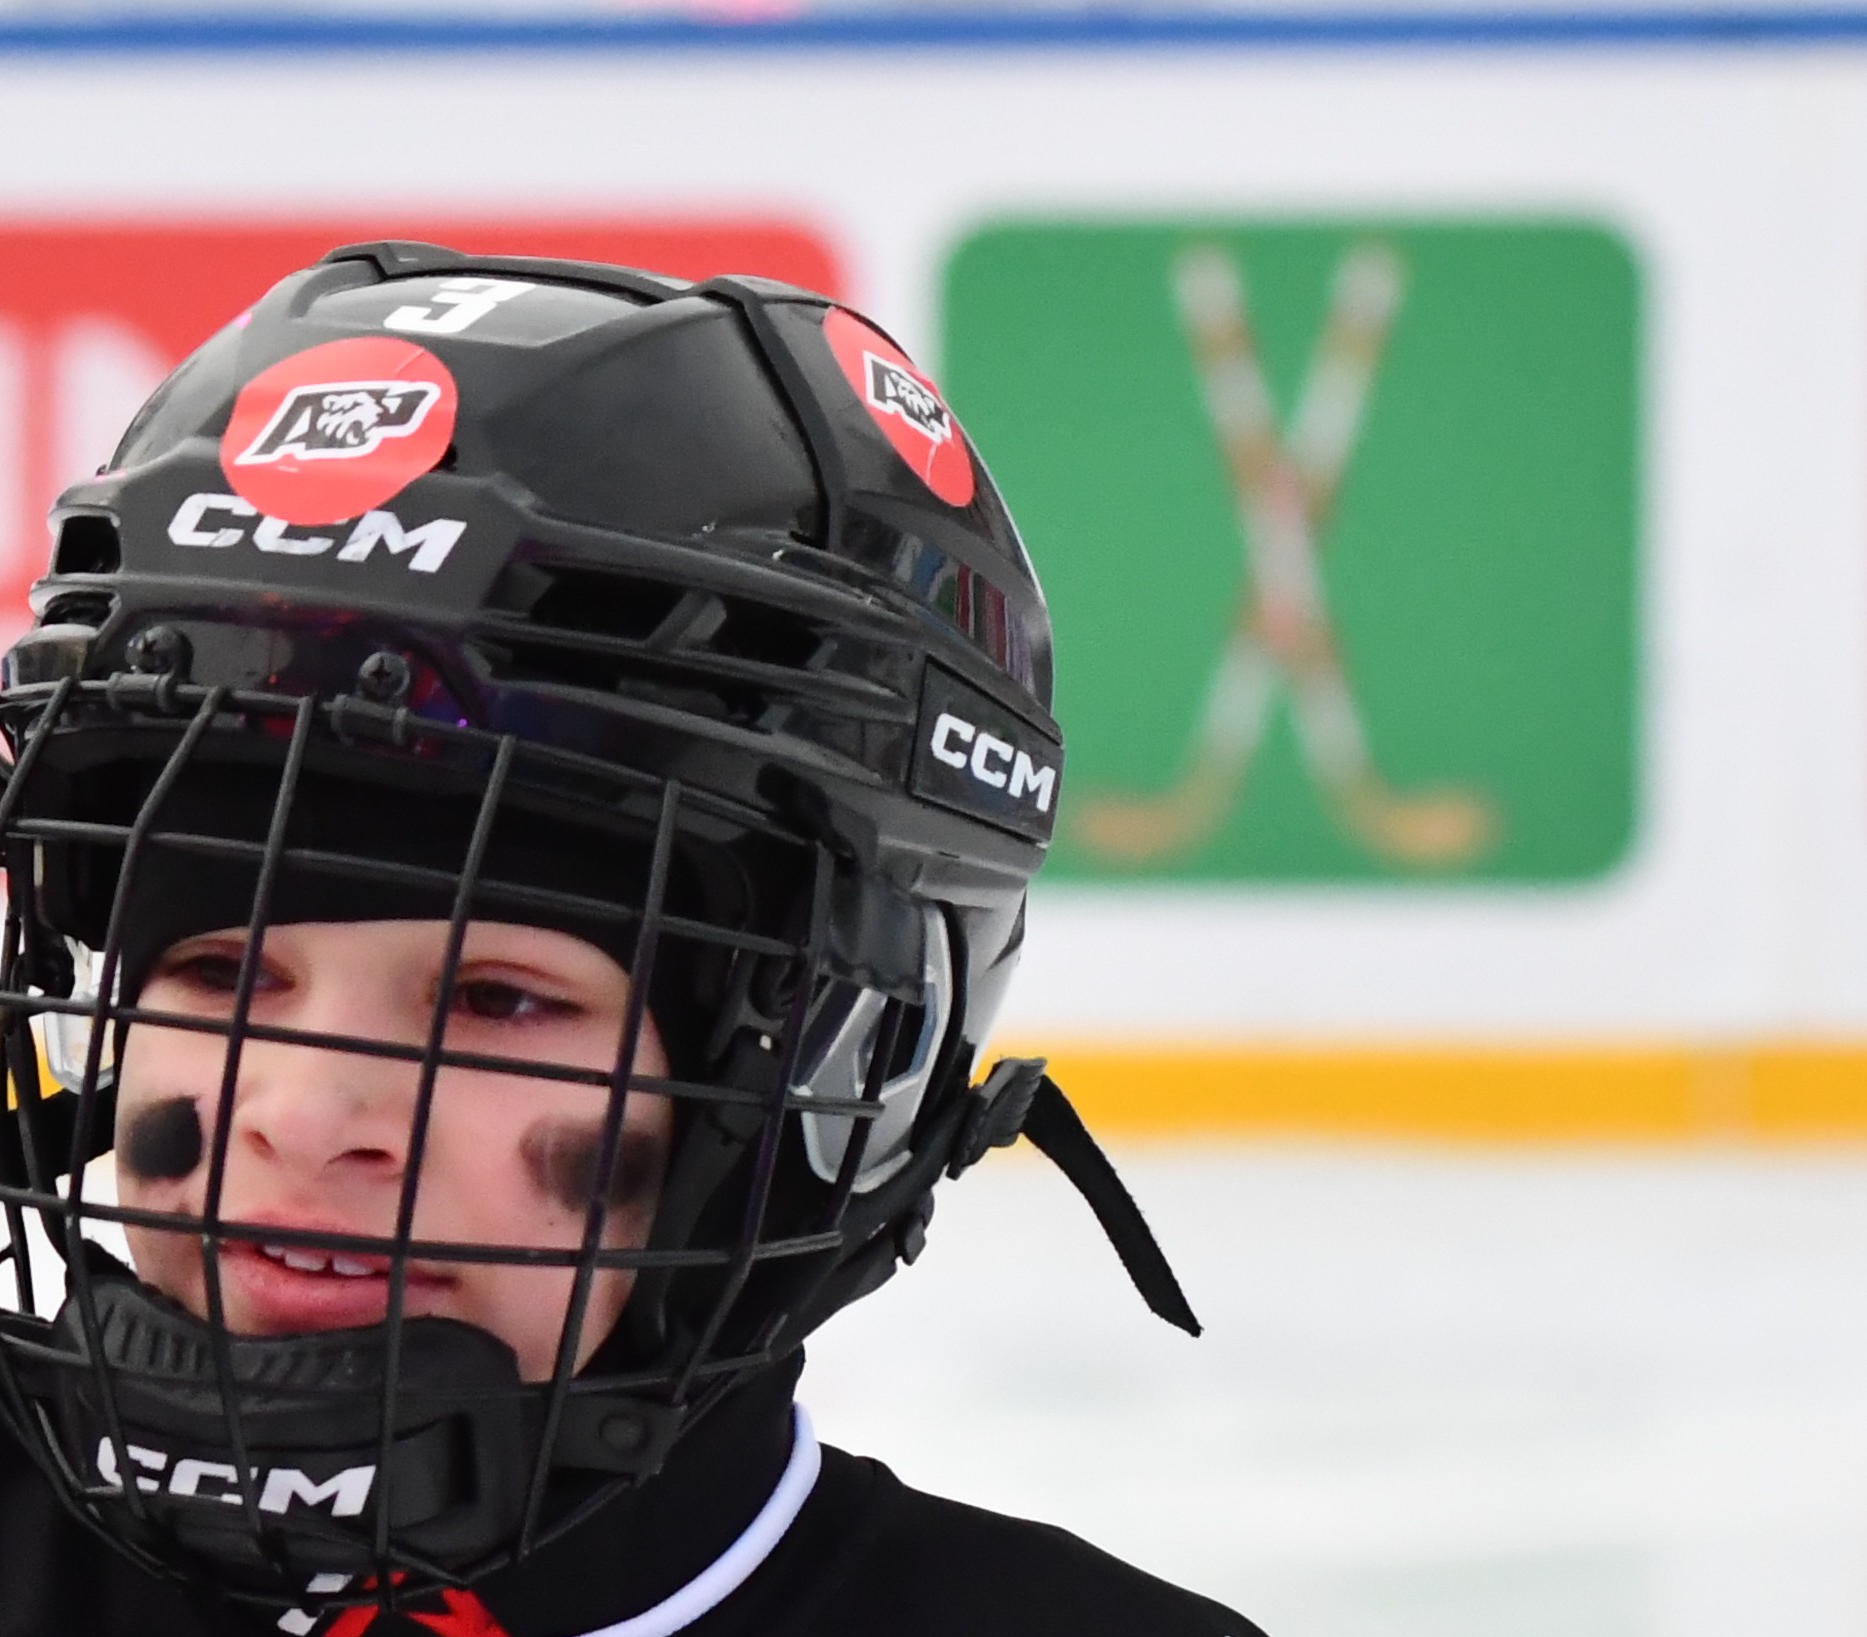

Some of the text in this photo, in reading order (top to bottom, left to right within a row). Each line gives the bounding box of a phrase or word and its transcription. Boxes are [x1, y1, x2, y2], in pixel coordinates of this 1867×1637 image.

[383, 277, 535, 335] 3
[168, 493, 467, 574] CCM
[931, 712, 1057, 812] CCM
[96, 1435, 377, 1518] CCM
